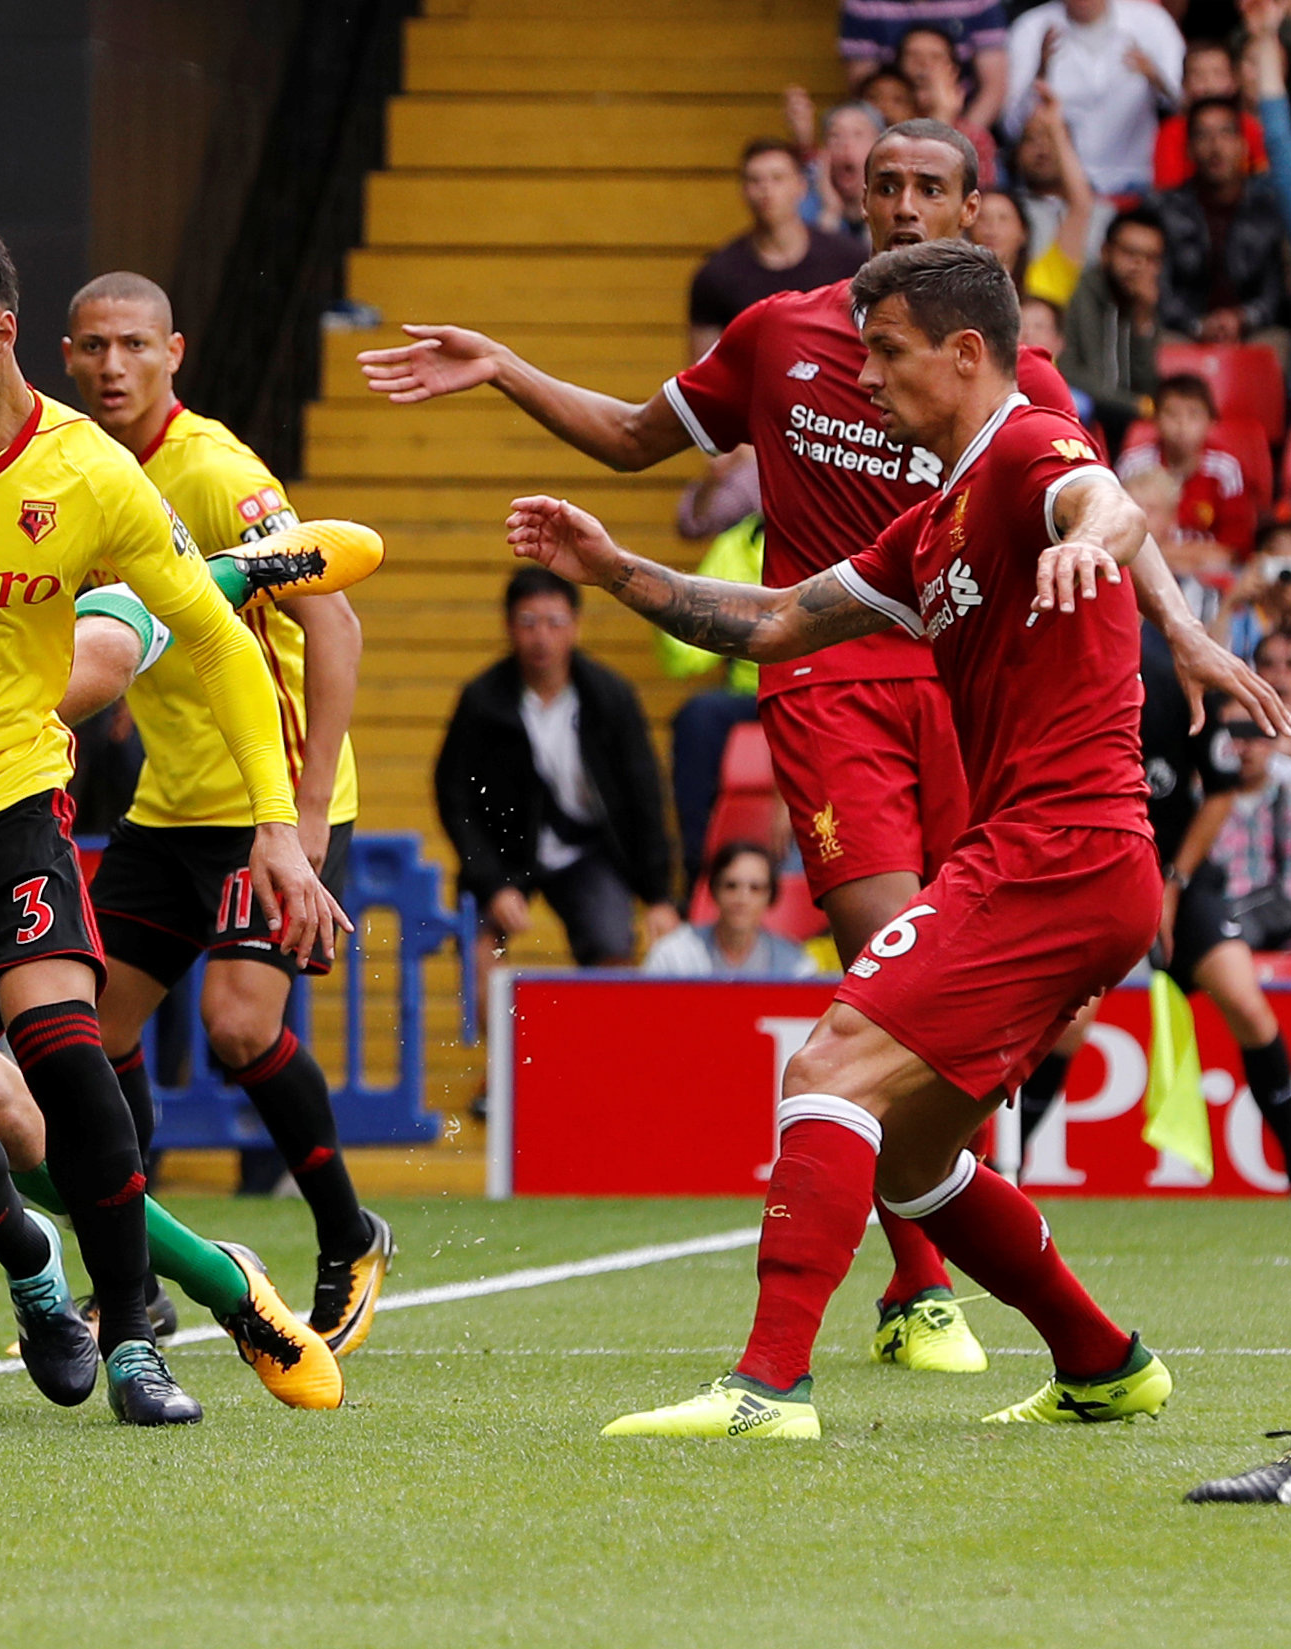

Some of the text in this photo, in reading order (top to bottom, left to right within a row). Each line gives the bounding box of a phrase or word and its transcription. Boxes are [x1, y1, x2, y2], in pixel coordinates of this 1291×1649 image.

[13, 876, 54, 944] 3
[216, 866, 253, 934] 11
[870, 904, 938, 957] 6
[728, 1408, 781, 1436] adidas
